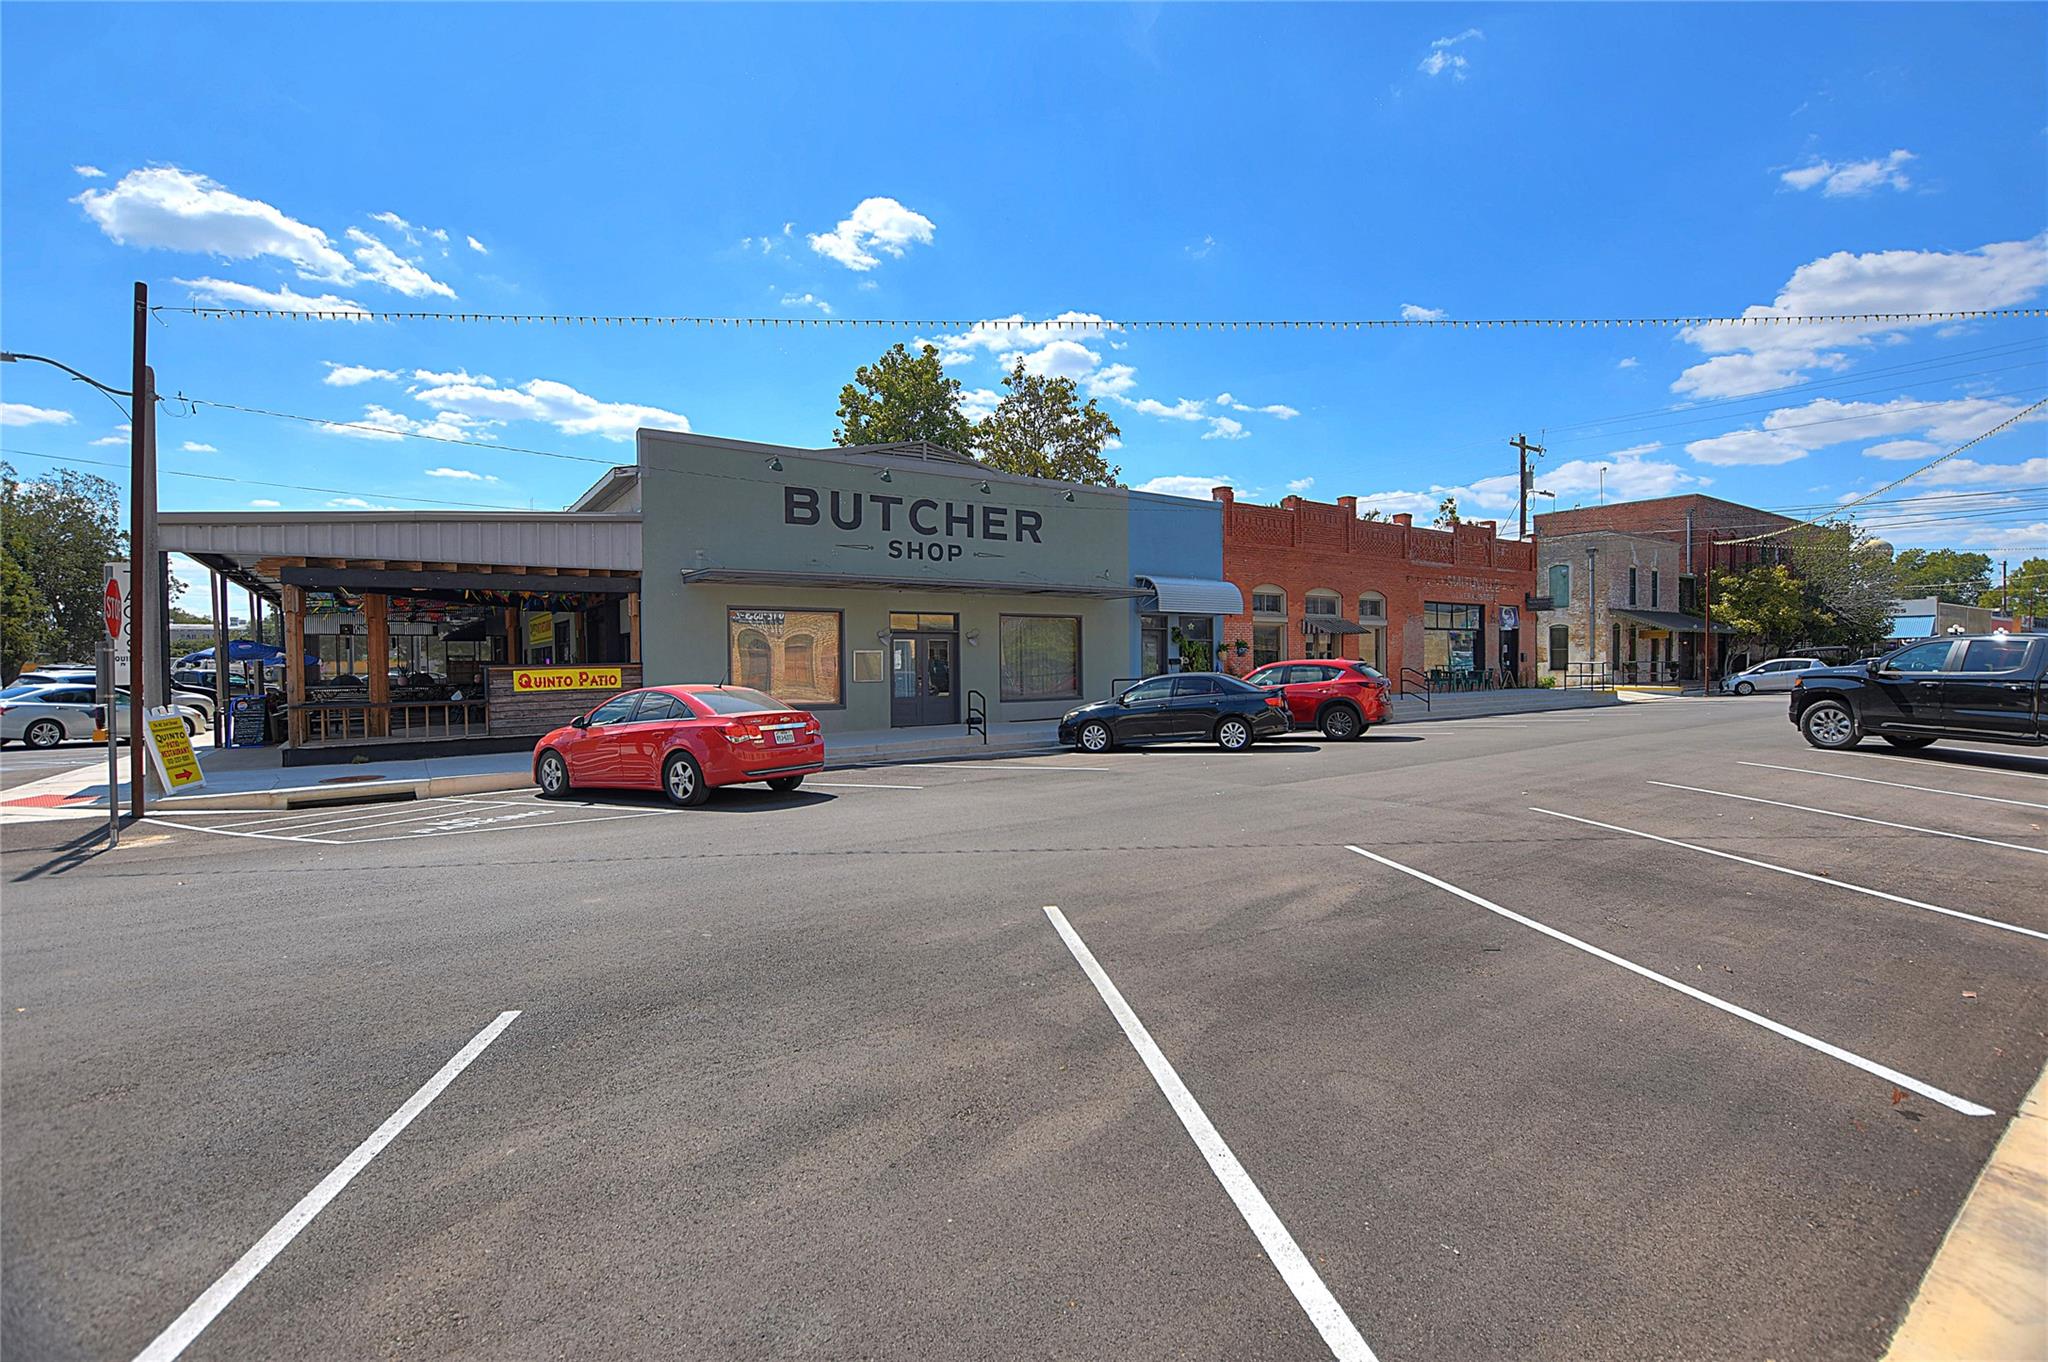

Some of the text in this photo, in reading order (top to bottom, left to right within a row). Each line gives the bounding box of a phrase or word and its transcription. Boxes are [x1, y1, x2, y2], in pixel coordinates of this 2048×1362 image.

[784, 486, 1042, 544] BUTCHER
[888, 539, 963, 562] SHOP
[106, 596, 121, 620] STOP
[518, 671, 618, 689] QUINTO PATIO
[155, 732, 185, 743] QUINTO
